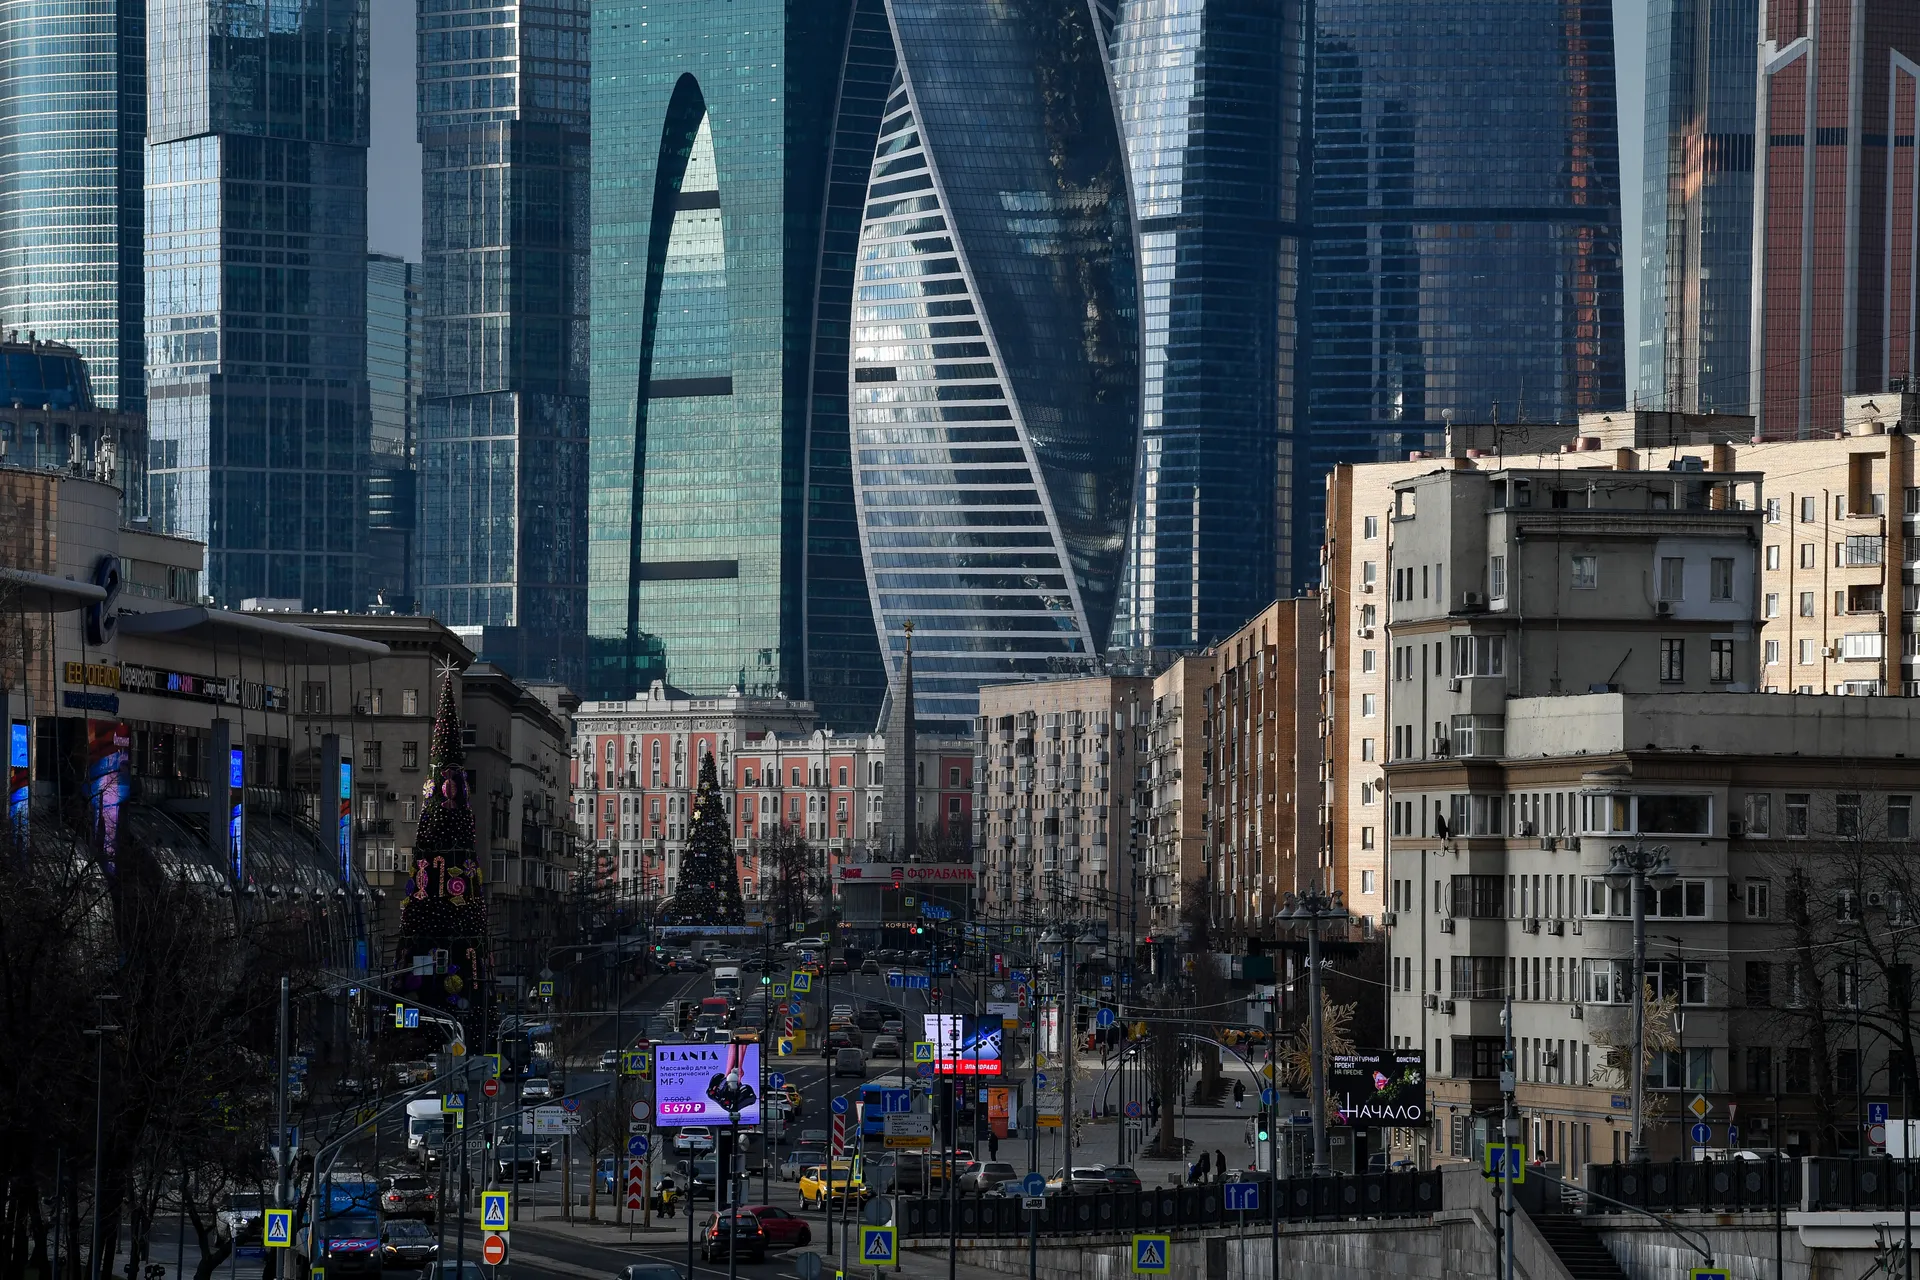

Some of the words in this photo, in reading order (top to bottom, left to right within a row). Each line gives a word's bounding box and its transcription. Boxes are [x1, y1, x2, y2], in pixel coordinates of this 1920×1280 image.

[907, 868, 975, 880] ФОРАБАНК
[660, 1051, 718, 1061] PLANTA
[660, 1078, 684, 1086] MF-9
[664, 1104, 671, 1113] 5
[672, 1104, 692, 1113] 679
[694, 1103, 702, 1112] ₽
[1340, 1092, 1421, 1120] НАЧАЛО
